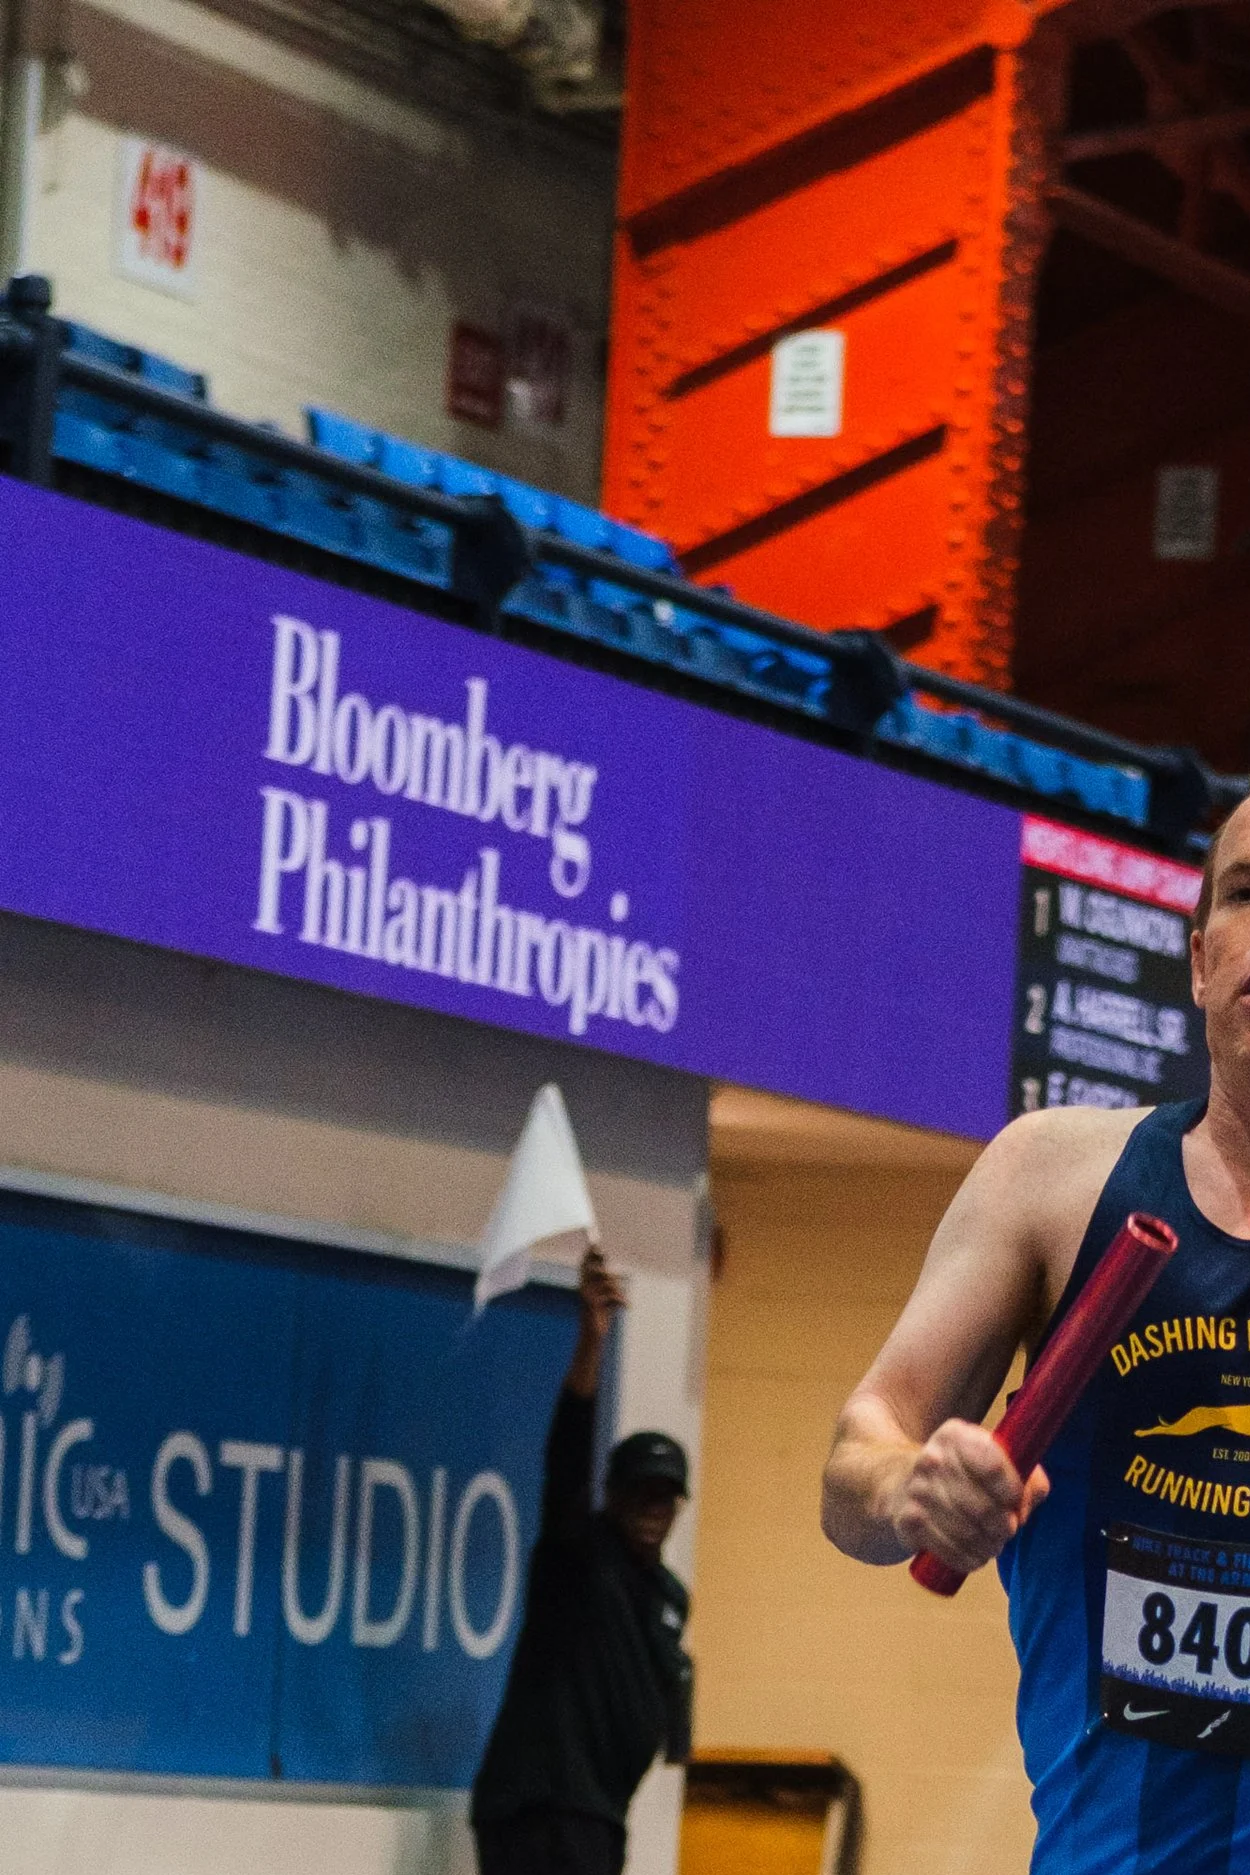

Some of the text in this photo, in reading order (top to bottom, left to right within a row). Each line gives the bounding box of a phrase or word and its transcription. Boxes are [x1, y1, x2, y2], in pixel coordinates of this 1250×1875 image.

[263, 613, 598, 898] Bloomberg
[251, 786, 680, 1035] Philanthropies
[1110, 1316, 1237, 1376] DASHING
[1220, 1373, 1241, 1386] NEW
[0, 1411, 521, 1660] IC USA STUDIO
